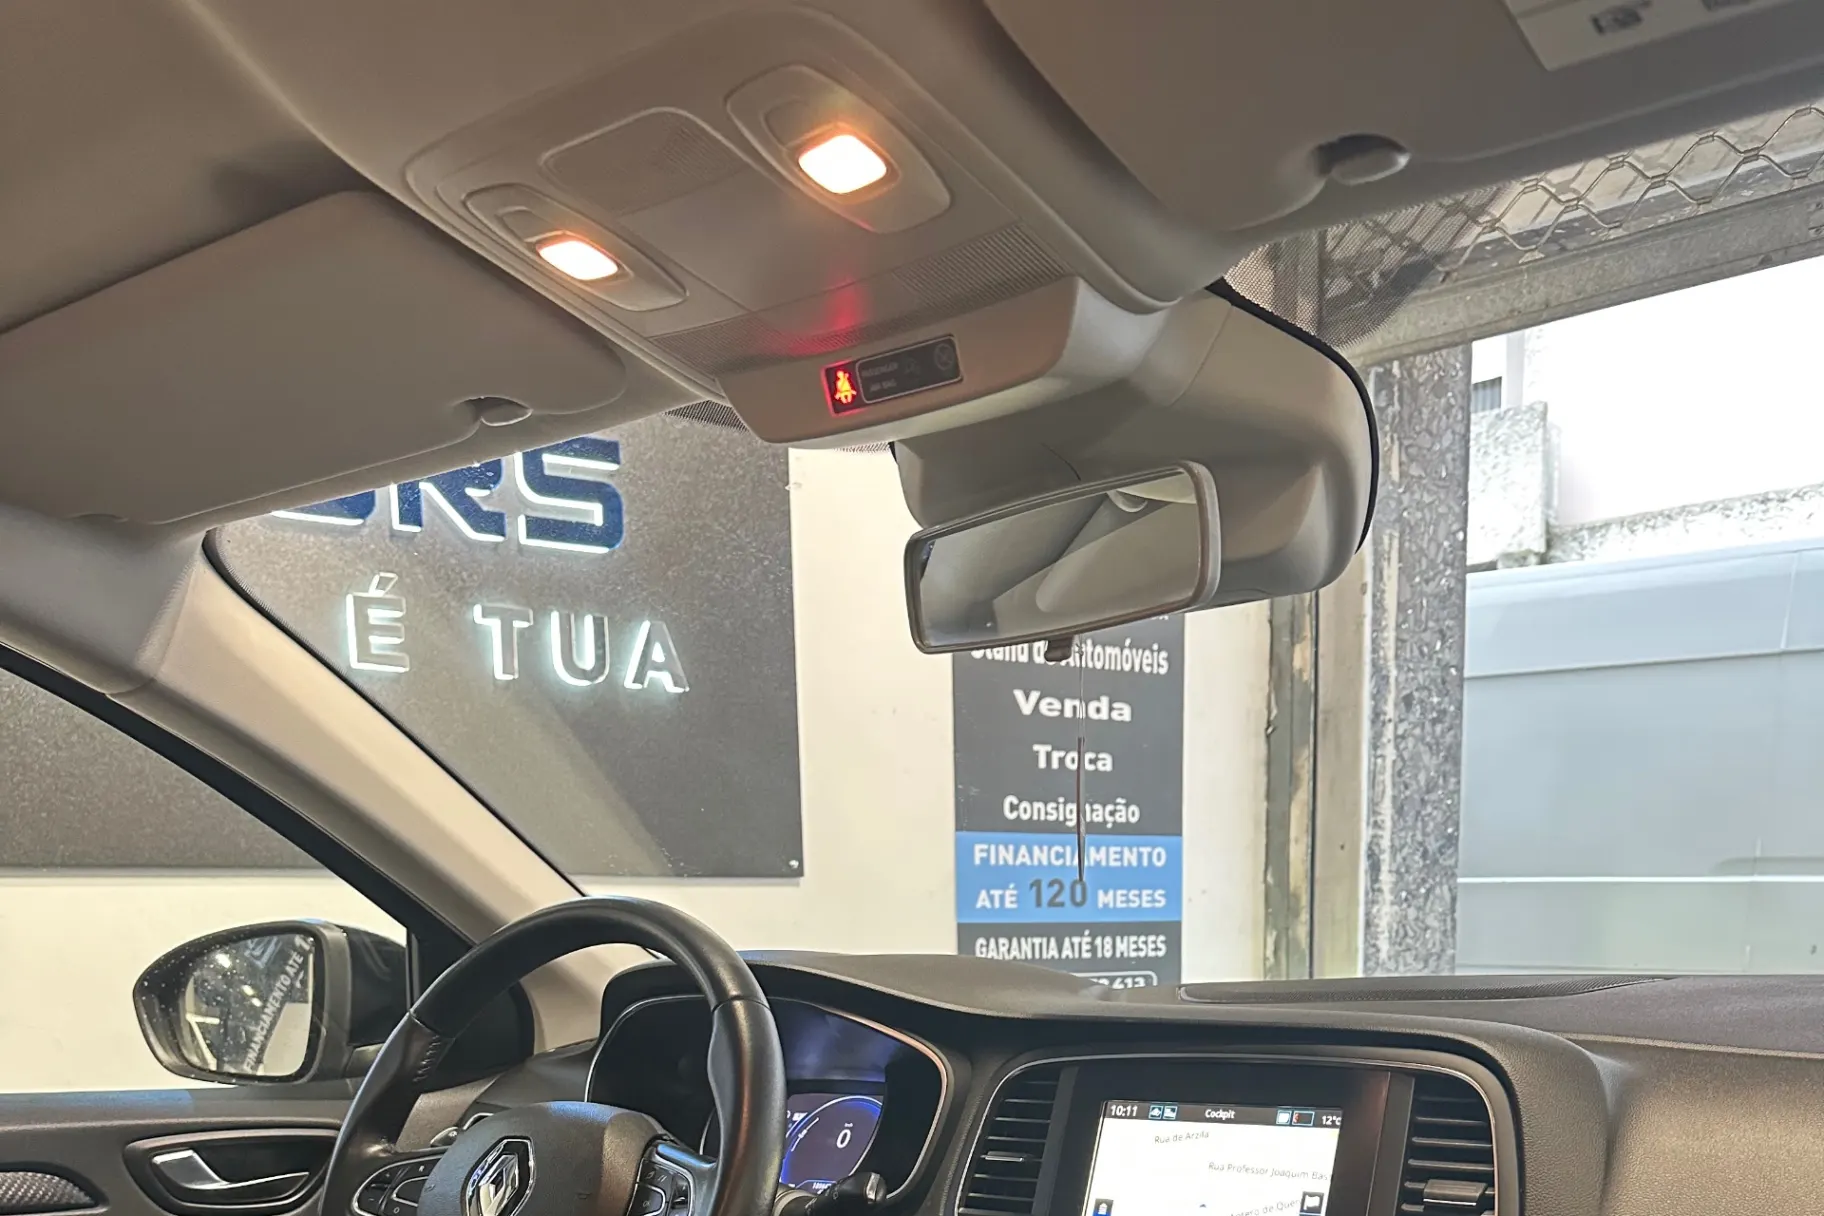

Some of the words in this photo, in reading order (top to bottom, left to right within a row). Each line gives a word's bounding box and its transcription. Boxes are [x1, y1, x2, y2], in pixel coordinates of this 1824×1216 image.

[272, 436, 624, 554] RS
[345, 571, 411, 673] É
[473, 603, 690, 694] TUA
[1013, 689, 1132, 722] Venda
[1032, 743, 1113, 772] Troca
[976, 883, 1018, 909] ATÉ
[1029, 878, 1088, 908] 120
[1097, 890, 1166, 909] MESES
[975, 936, 1060, 960] GARANTIA
[1061, 929, 1092, 960] ATÉ
[1095, 936, 1112, 959] 18
[1115, 935, 1167, 958] MESES
[1110, 1104, 1138, 1117] 10:11
[1205, 1108, 1236, 1120] Cockpit
[836, 1128, 851, 1149] 0
[1154, 1135, 1170, 1144] Rua
[1172, 1133, 1183, 1142] de
[1208, 1162, 1225, 1171] Rua
[1227, 1163, 1268, 1175] Professor
[1270, 1167, 1309, 1181] Joaquim
[1262, 1204, 1274, 1214] de
